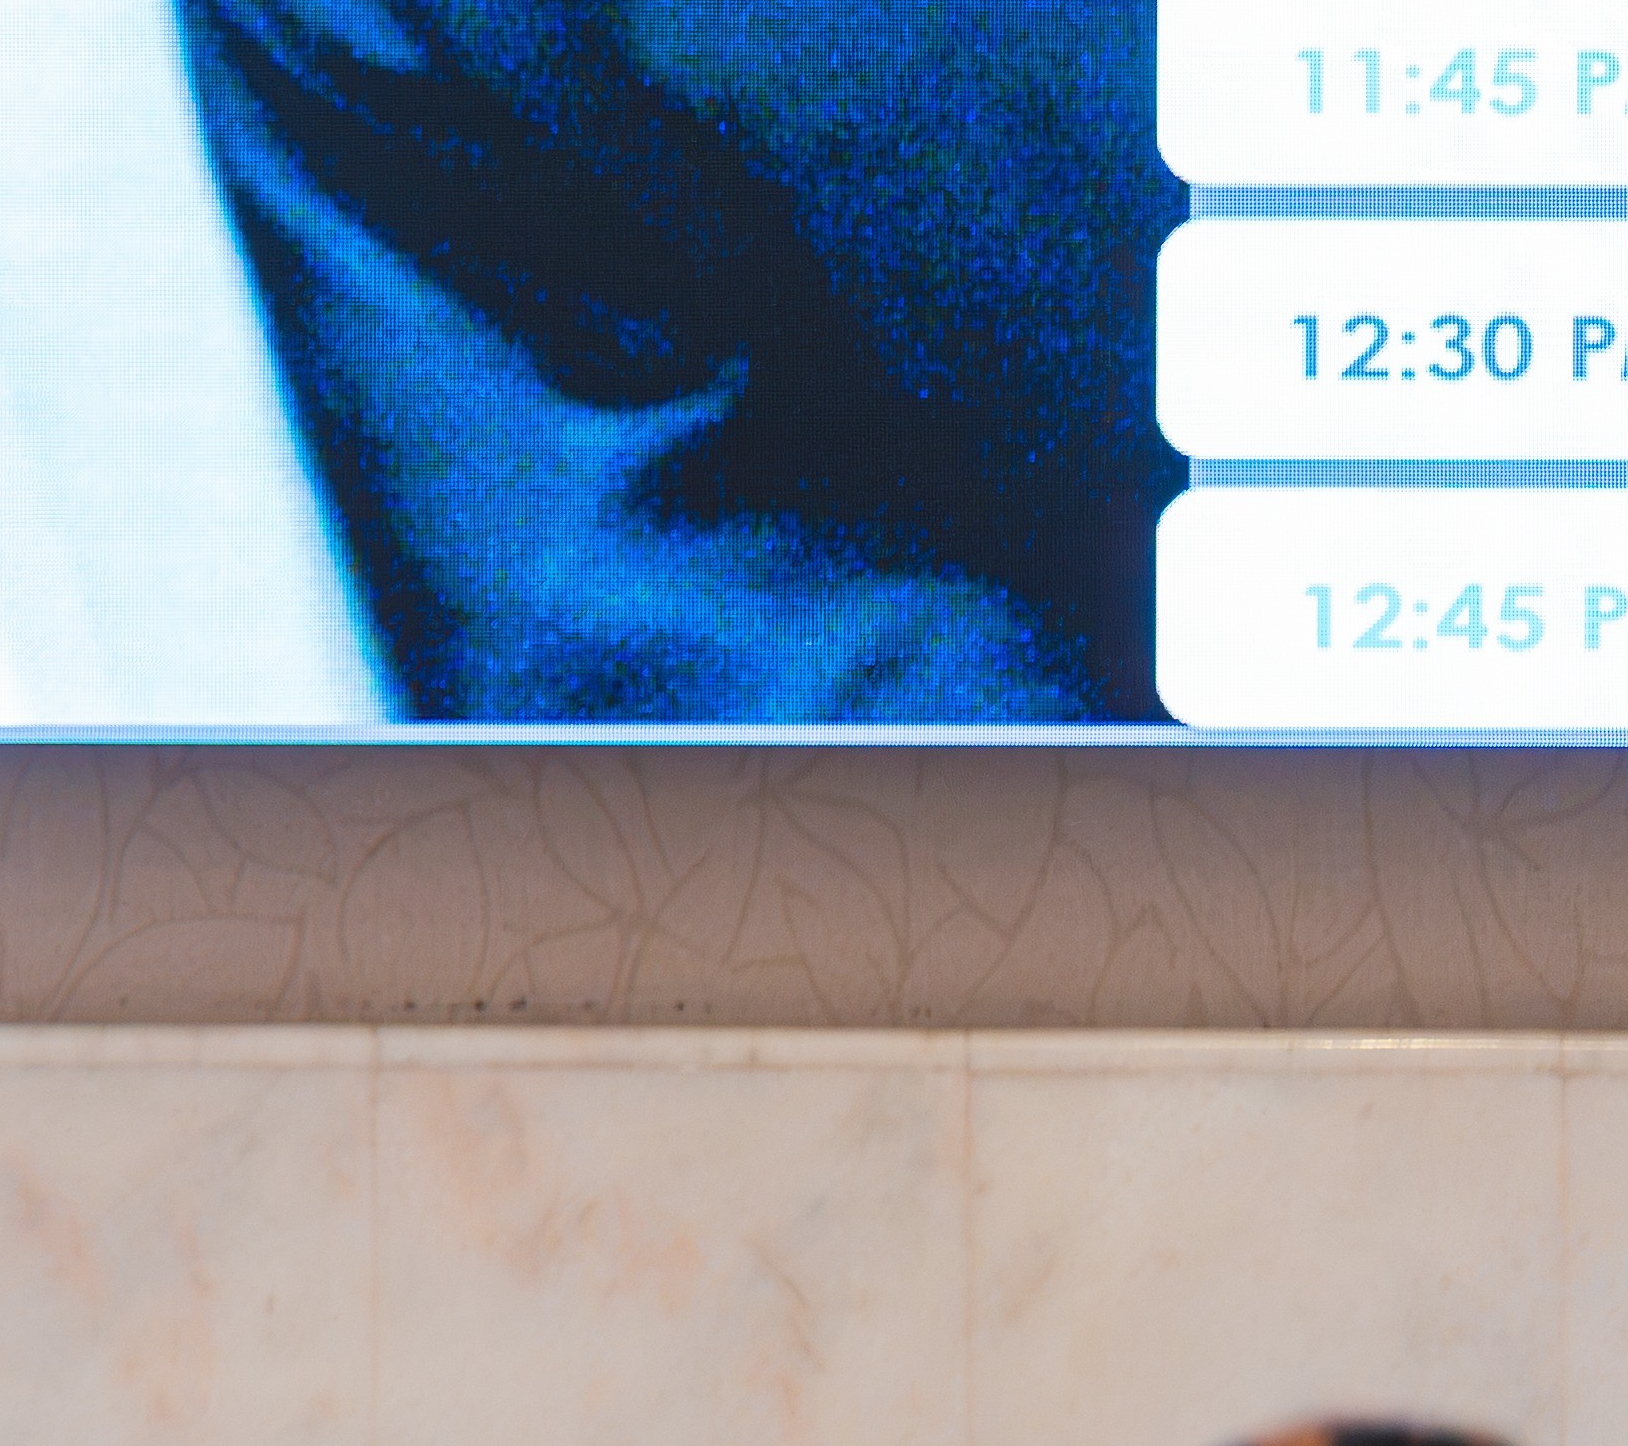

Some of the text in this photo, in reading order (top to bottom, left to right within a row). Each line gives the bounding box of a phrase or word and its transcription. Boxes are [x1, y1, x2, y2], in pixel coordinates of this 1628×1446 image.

[1295, 46, 1628, 118] 11:45 P
[1289, 310, 1628, 384] 12:30 P
[1303, 581, 1547, 653] 12:45
